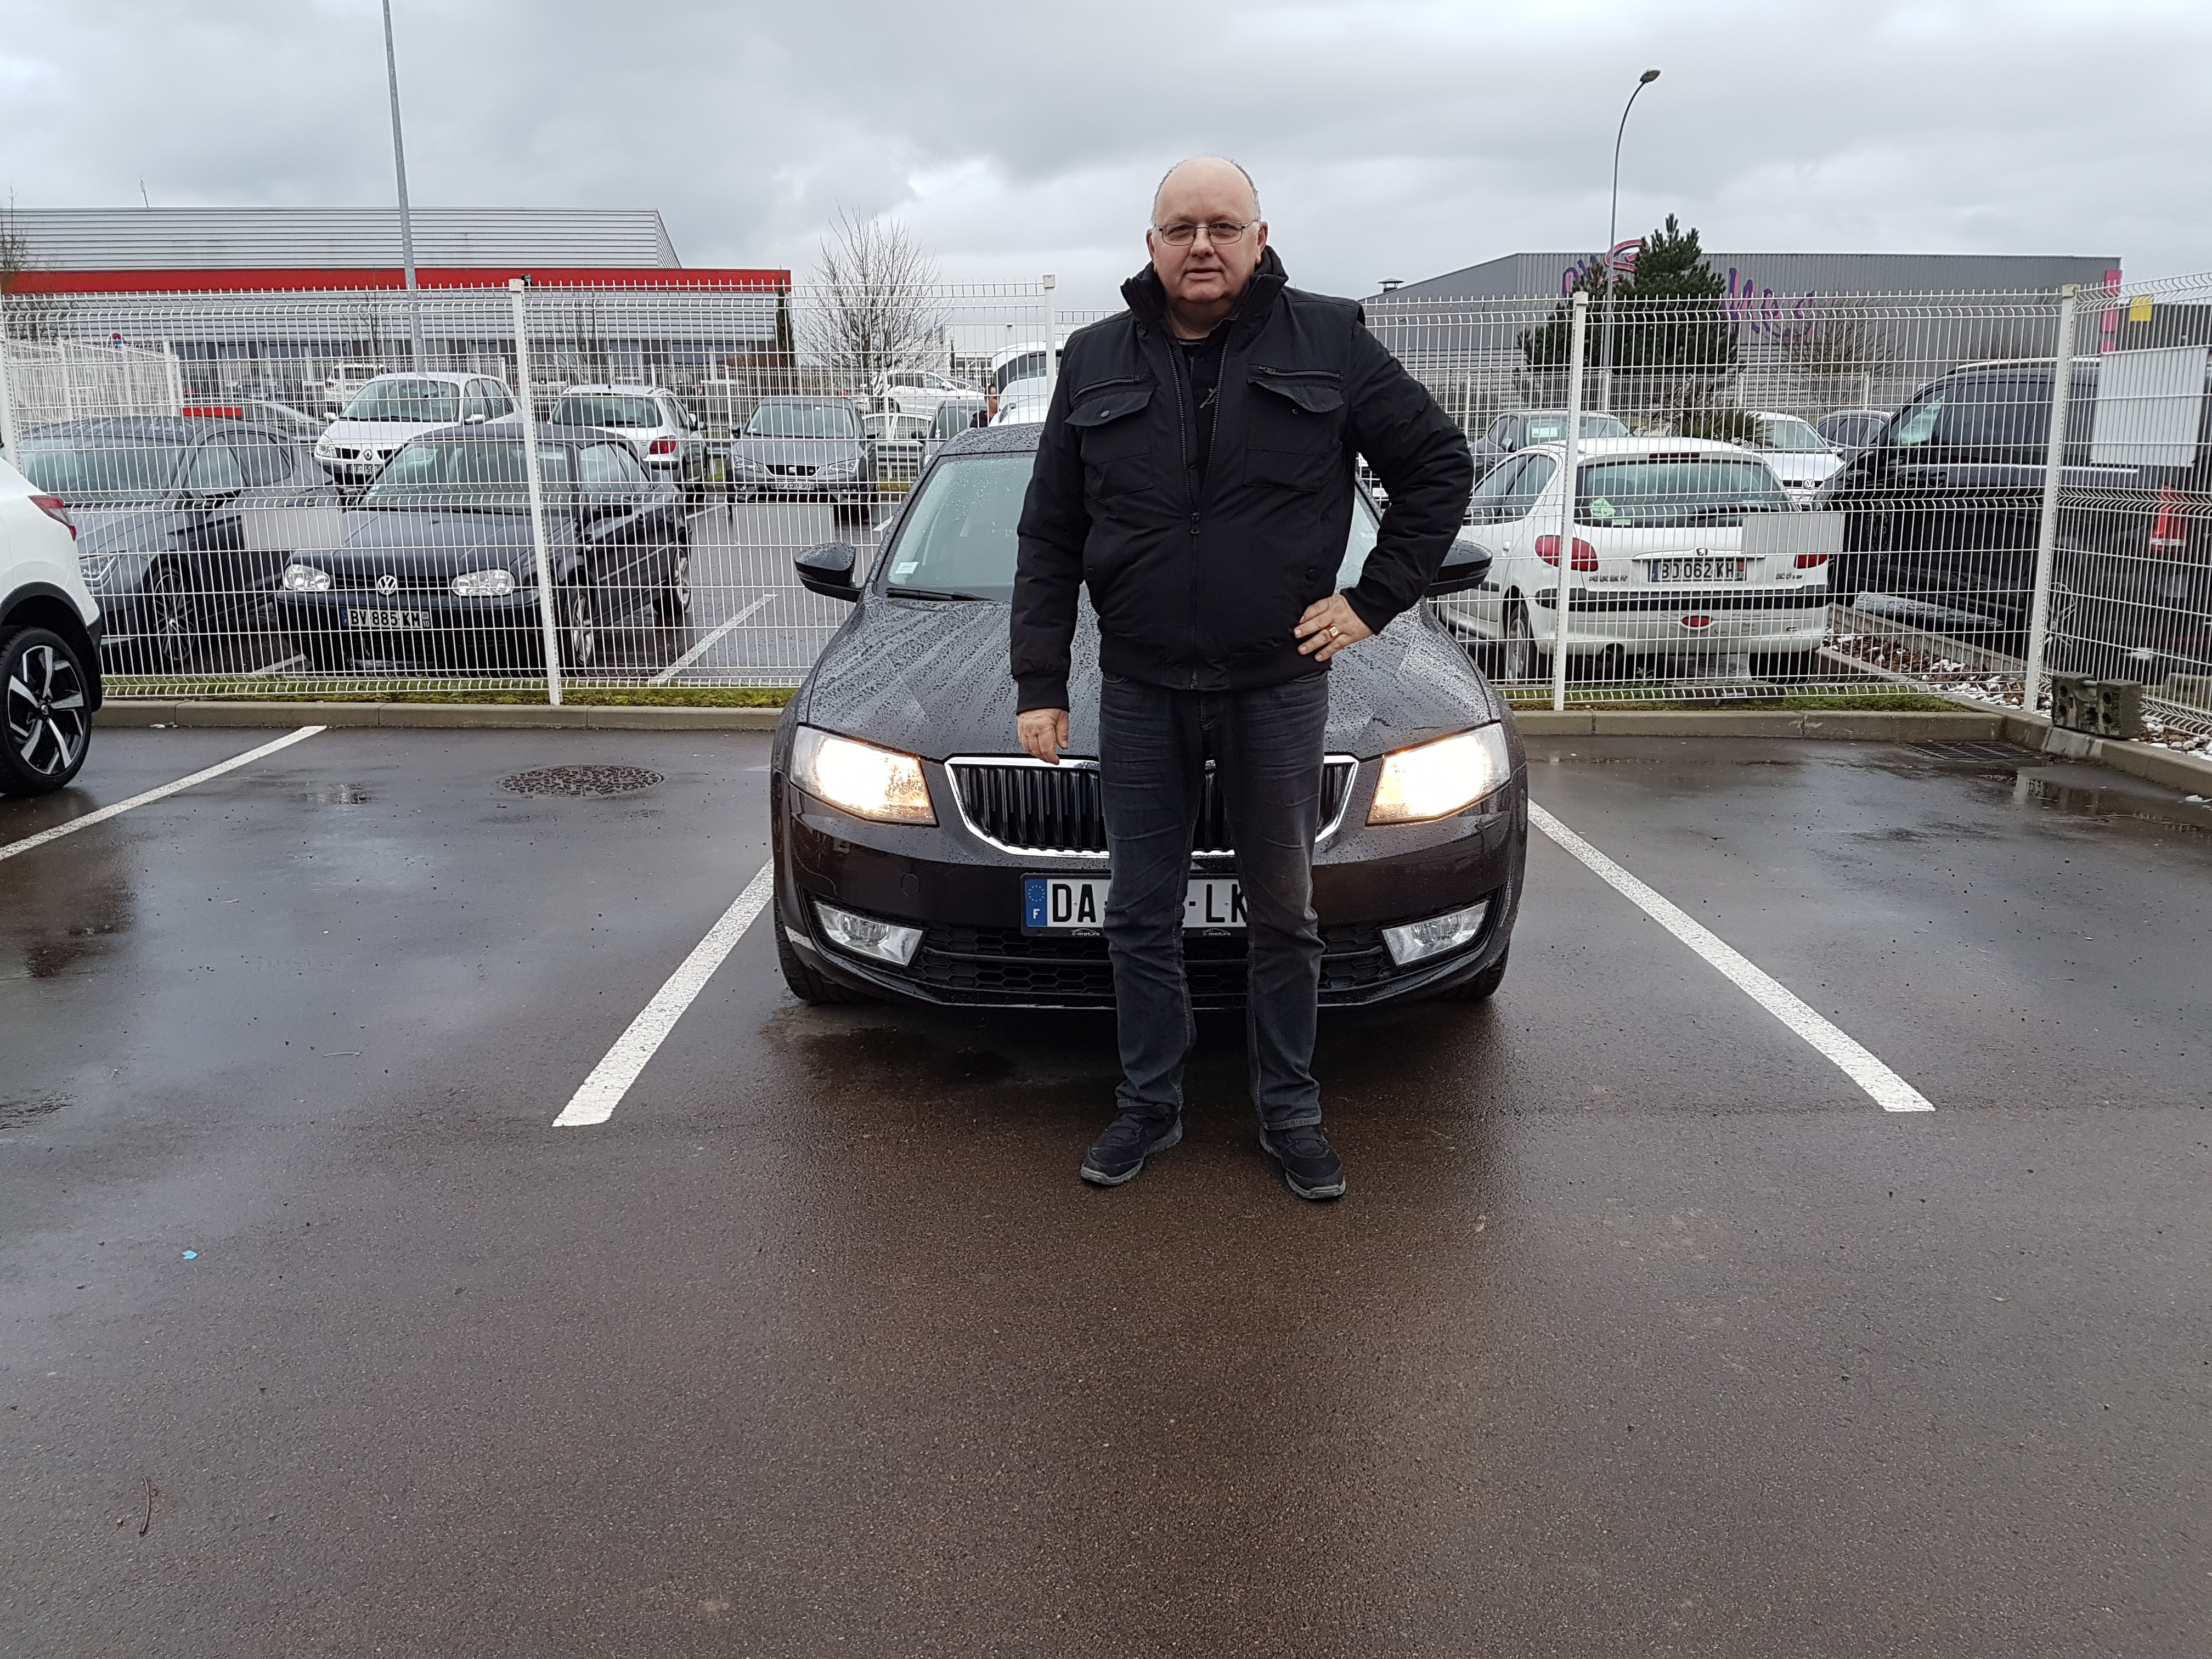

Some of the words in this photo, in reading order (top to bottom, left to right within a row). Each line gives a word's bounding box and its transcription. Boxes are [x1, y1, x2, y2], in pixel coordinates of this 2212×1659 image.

[1684, 563, 1712, 578] 062
[1716, 562, 1734, 578] KH
[350, 610, 366, 625] BV
[371, 611, 398, 626] 885
[402, 612, 421, 627] KM
[1032, 909, 1040, 919] F
